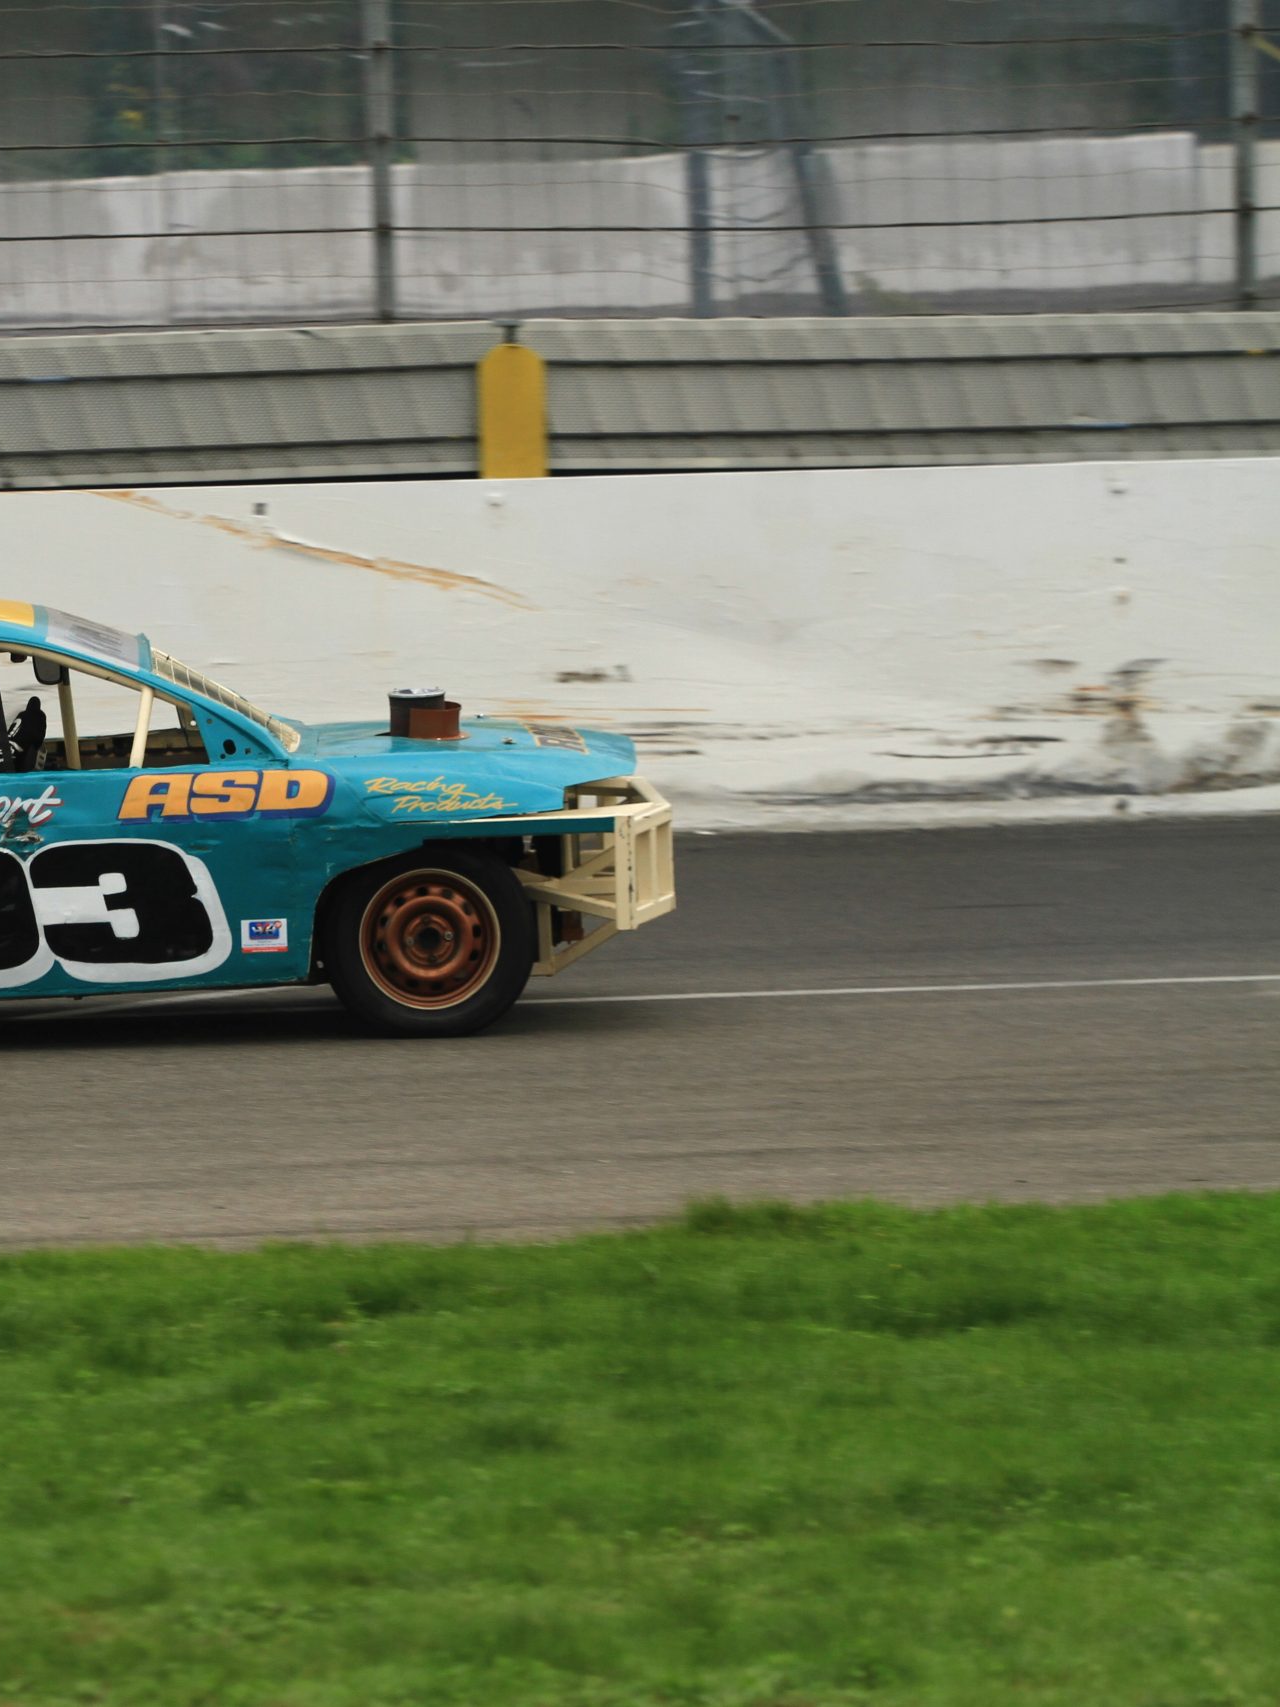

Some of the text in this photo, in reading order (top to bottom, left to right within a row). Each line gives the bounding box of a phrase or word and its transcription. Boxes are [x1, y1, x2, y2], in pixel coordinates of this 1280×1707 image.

[118, 769, 335, 824] ASD
[363, 775, 481, 804] Racing
[391, 793, 519, 814] Products
